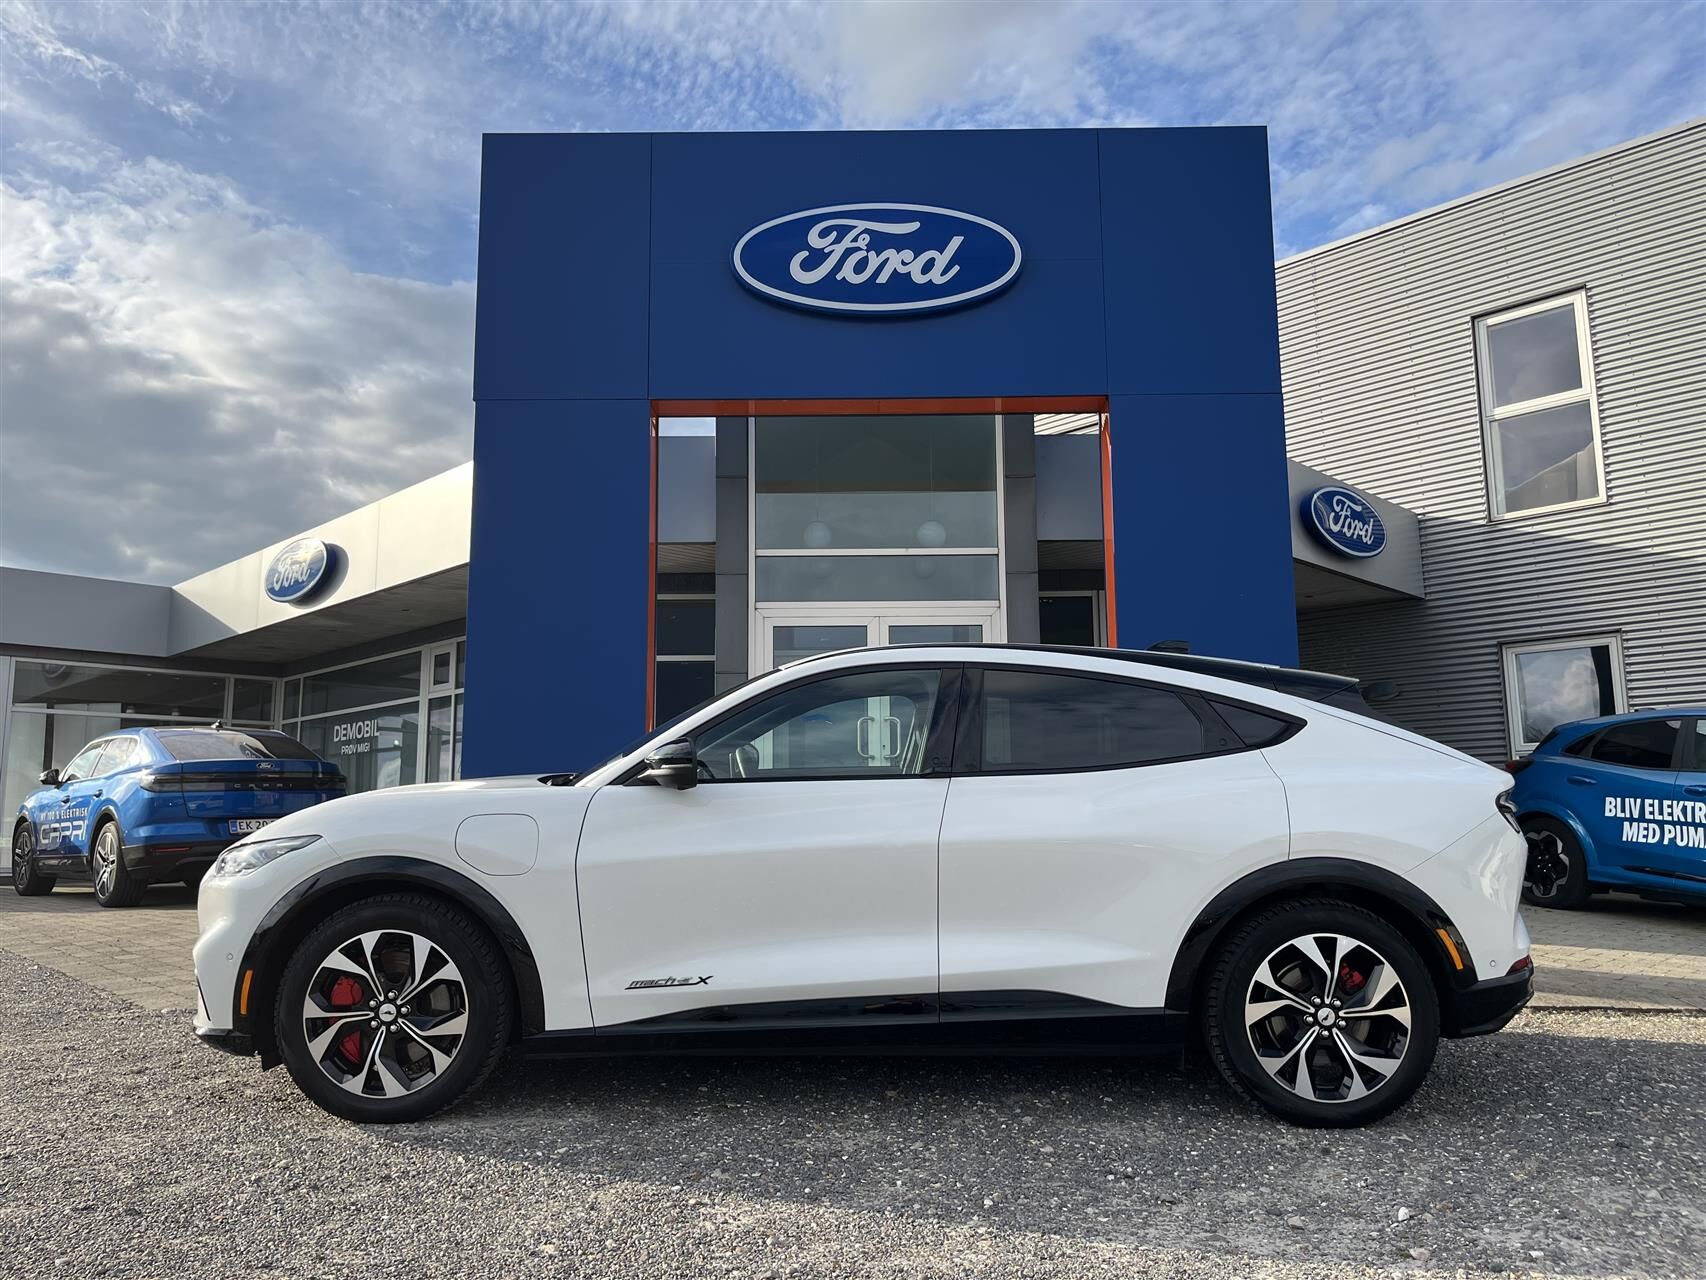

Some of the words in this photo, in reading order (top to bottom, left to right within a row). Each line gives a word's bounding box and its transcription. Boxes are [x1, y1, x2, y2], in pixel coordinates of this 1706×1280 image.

[790, 219, 964, 285] Ford
[1329, 495, 1374, 545] Ford
[273, 550, 311, 592] Ford
[333, 719, 380, 743] DEMOBIL
[1604, 796, 1641, 818] BLIV
[238, 821, 253, 831] EK
[1622, 821, 1660, 843] MED
[1663, 824, 1706, 849] PUM
